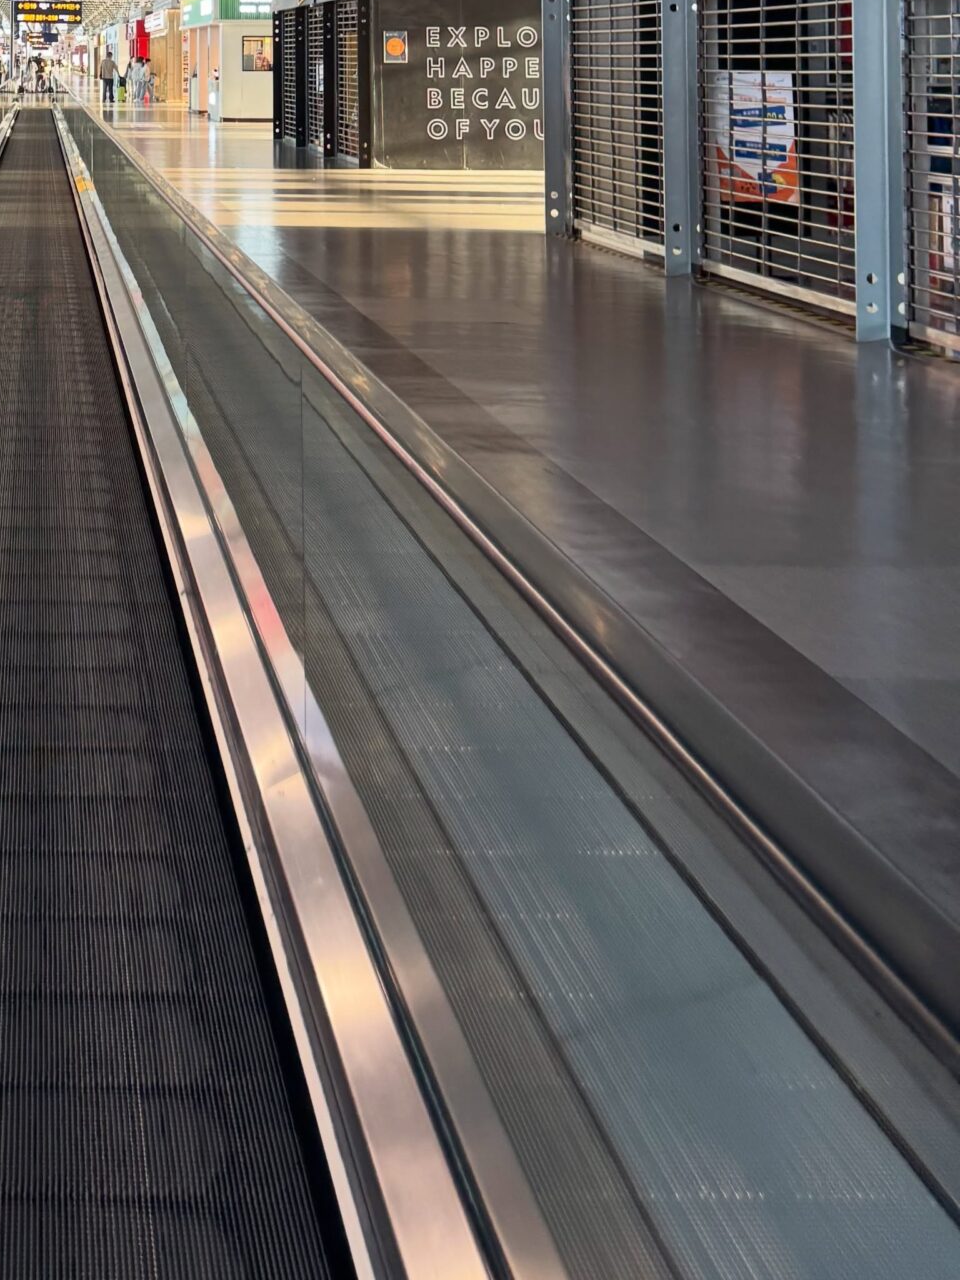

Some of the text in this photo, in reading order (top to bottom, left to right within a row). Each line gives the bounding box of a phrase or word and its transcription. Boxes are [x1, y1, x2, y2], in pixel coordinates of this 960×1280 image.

[425, 26, 538, 48] EXPLO
[426, 56, 540, 78] HAPPE
[426, 87, 540, 110] BECAU
[426, 118, 470, 140] OF
